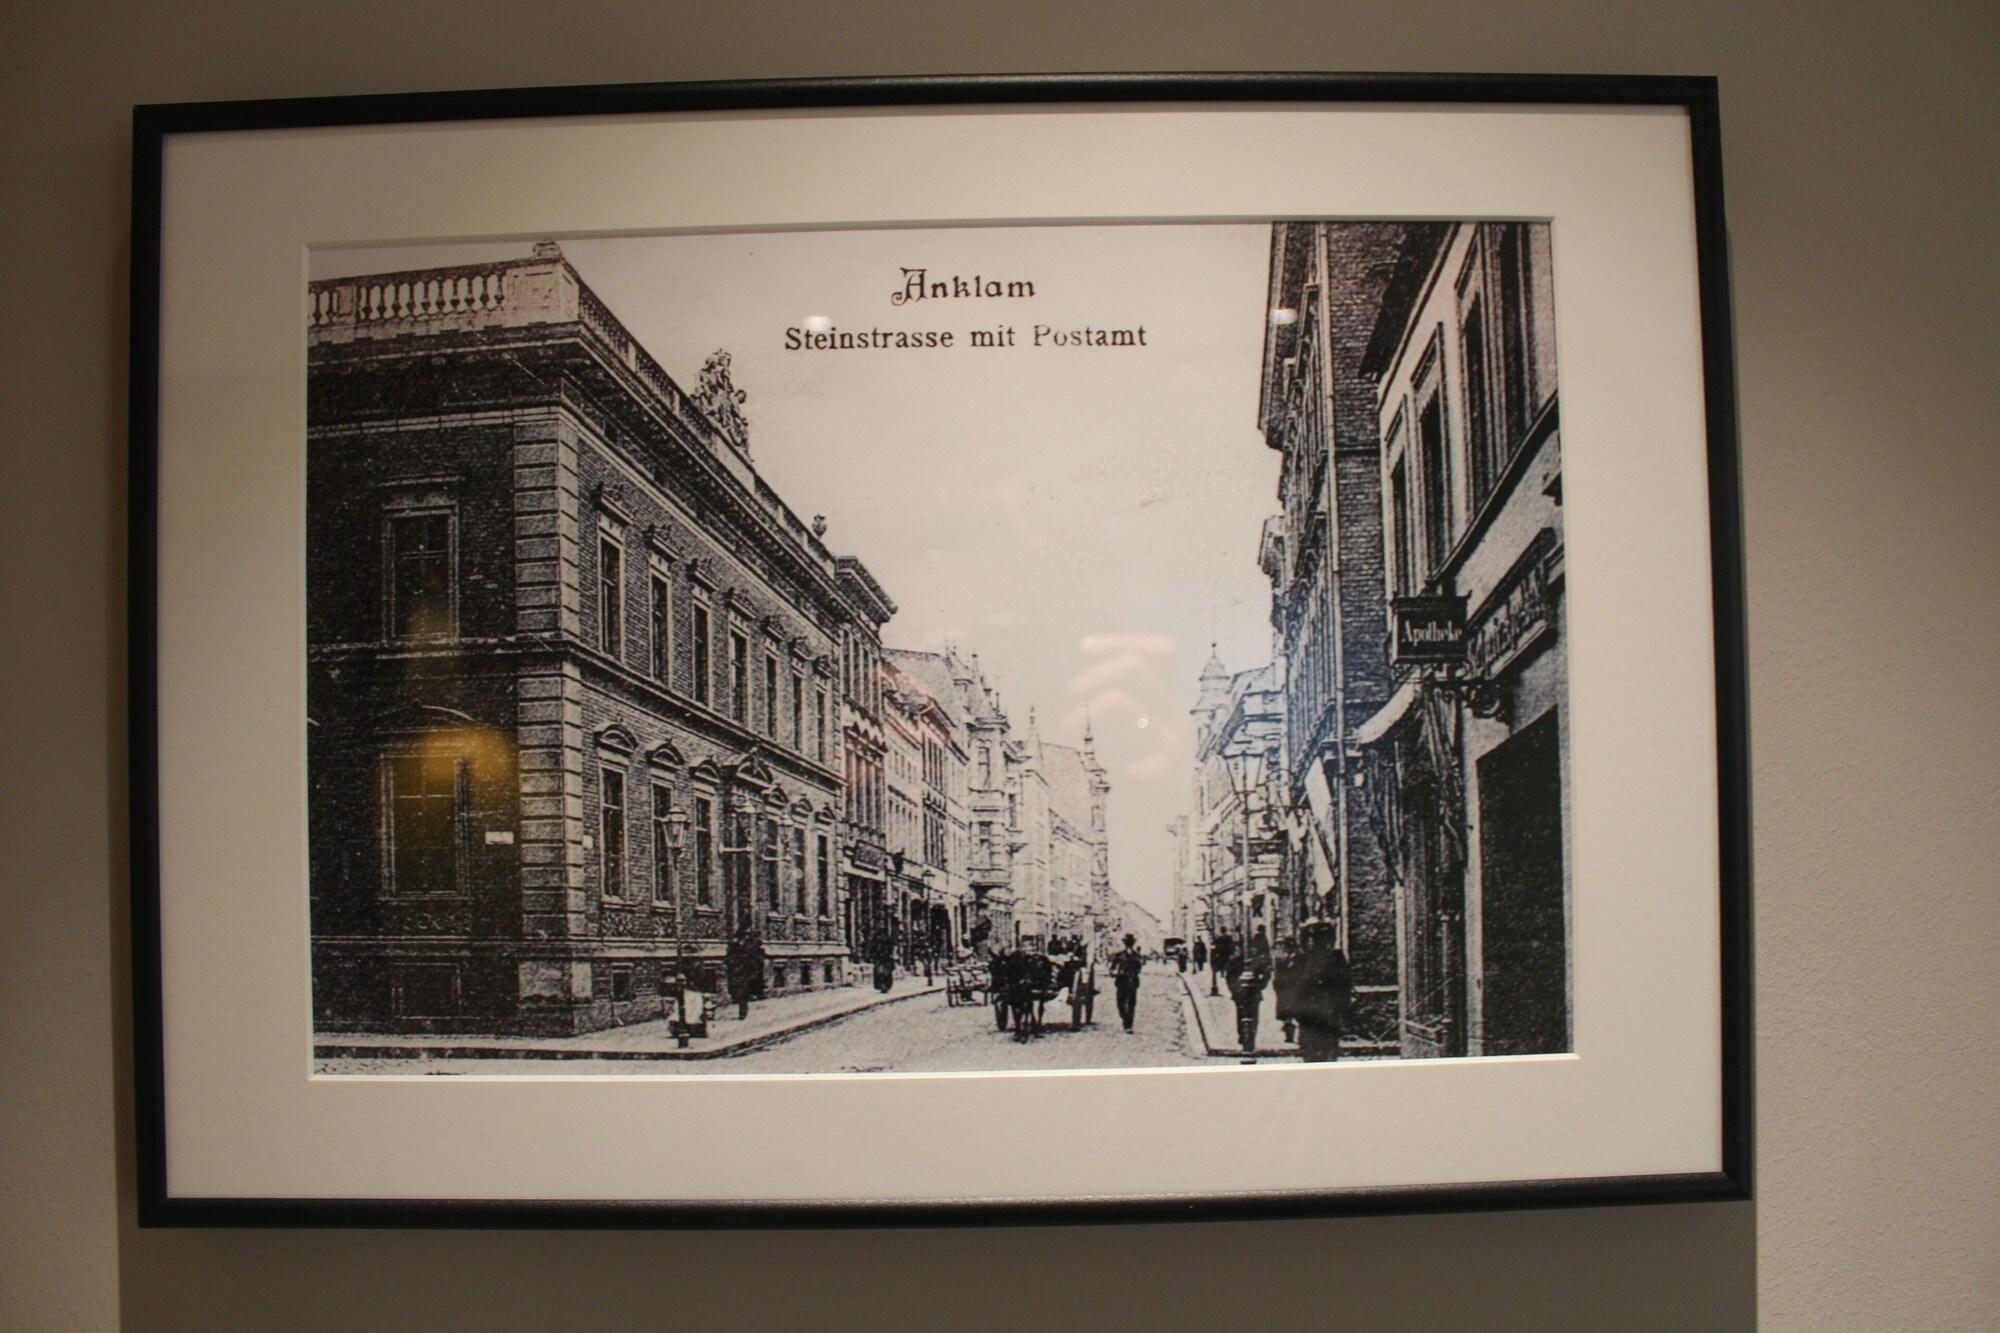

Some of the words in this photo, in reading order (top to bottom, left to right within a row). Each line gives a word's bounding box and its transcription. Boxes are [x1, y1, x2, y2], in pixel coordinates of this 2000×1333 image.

[891, 267, 1036, 306] Anklam
[785, 326, 954, 350] Steinstrasse
[970, 325, 1016, 347] mit
[1033, 324, 1148, 347] Postamt
[1401, 619, 1463, 647] Apotheke
